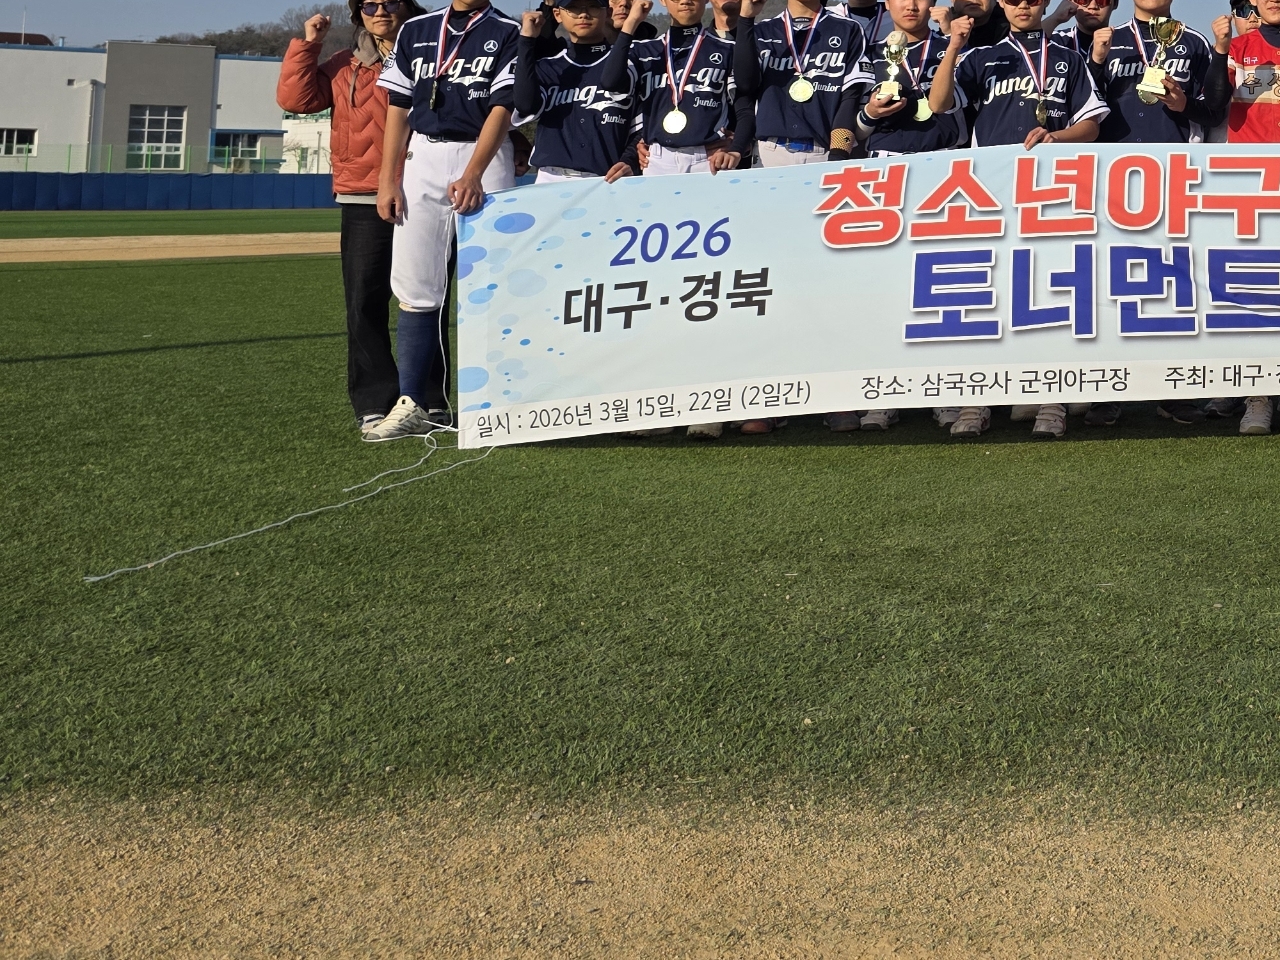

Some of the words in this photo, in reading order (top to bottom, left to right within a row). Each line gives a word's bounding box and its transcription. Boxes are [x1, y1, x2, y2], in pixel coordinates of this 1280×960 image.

[1108, 57, 1191, 85] Jungu
[1243, 56, 1259, 65] 대구
[467, 88, 490, 101] Junio
[544, 85, 634, 112] Jung-
[640, 67, 726, 102] Jun-gu
[812, 81, 841, 93] Junior
[983, 75, 1067, 105] Junggu
[693, 96, 722, 108] Junior
[609, 216, 732, 267] 2026
[563, 267, 774, 334] 대구·경북
[861, 374, 913, 400] 장소:
[920, 370, 1013, 398] 삼국유사
[1018, 367, 1131, 394] 군위야구장
[1164, 364, 1214, 389] 주최:
[477, 413, 511, 438] 일시
[528, 403, 593, 430] 2026년
[599, 398, 630, 424] 3월
[637, 391, 682, 418] 15일,
[688, 386, 733, 413] 22일
[741, 380, 812, 410] (2일간)
